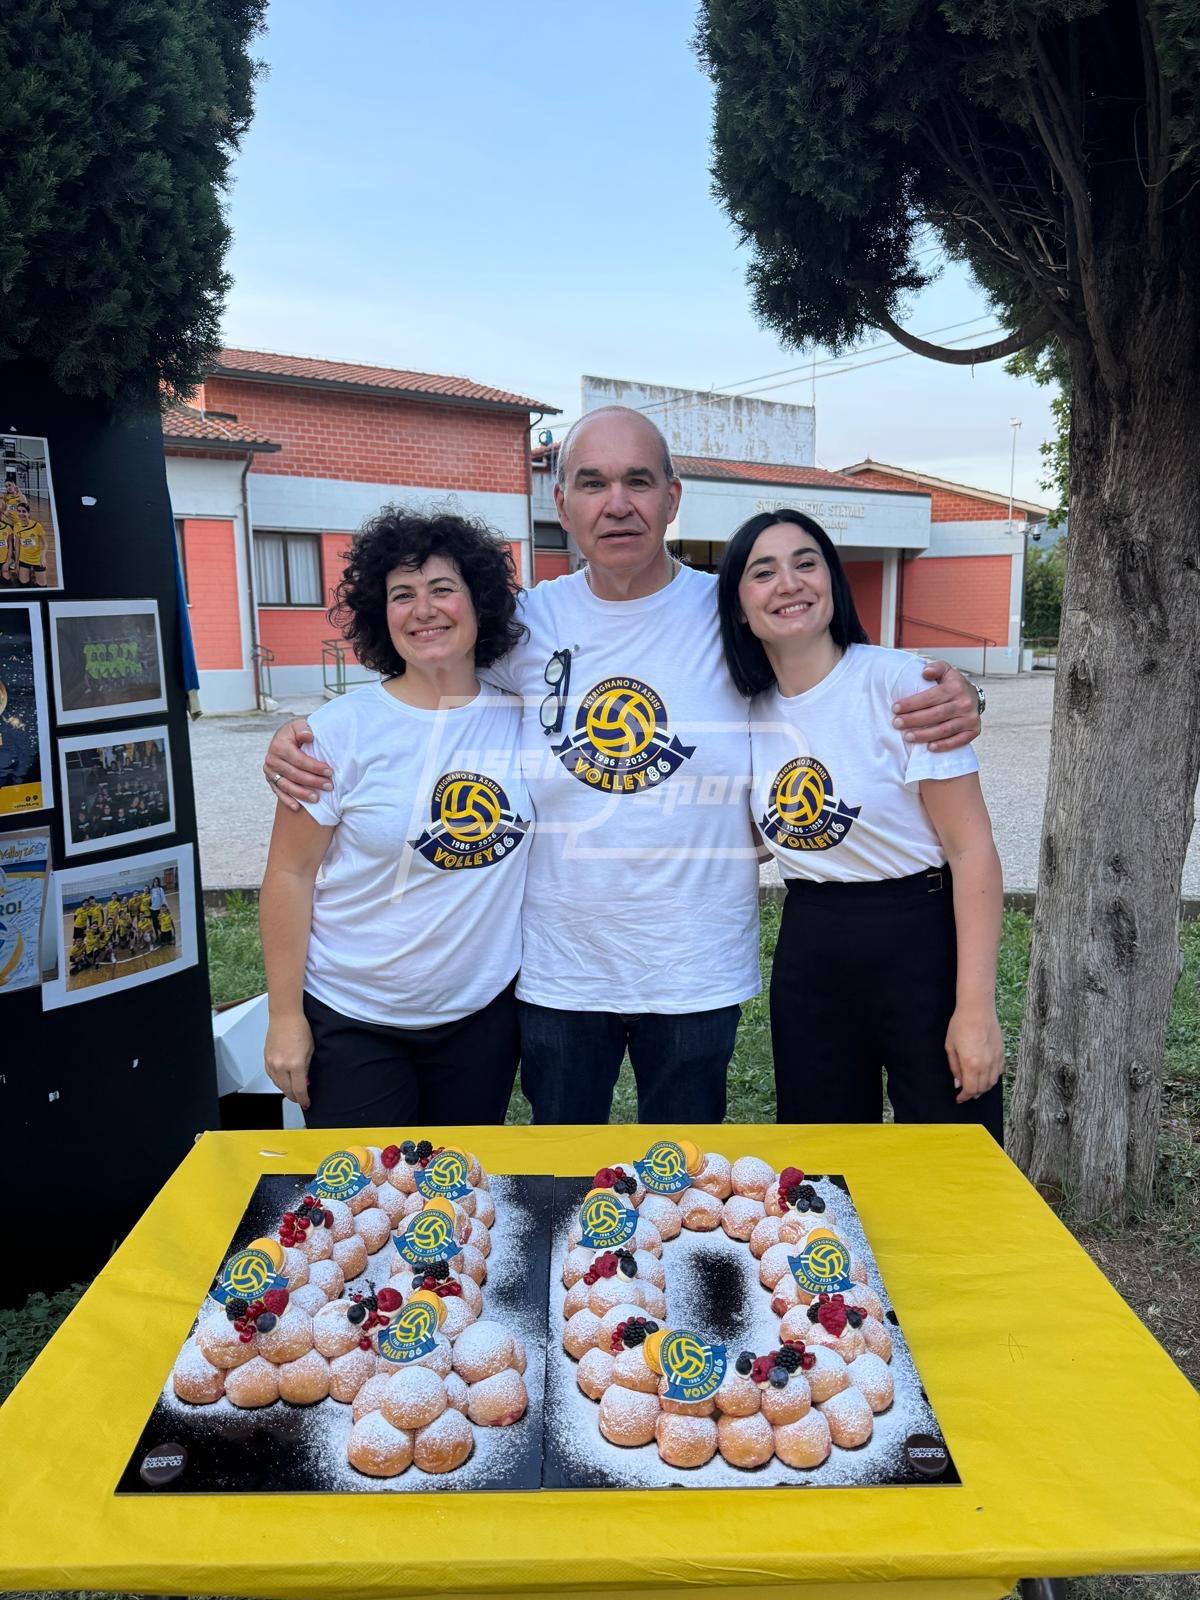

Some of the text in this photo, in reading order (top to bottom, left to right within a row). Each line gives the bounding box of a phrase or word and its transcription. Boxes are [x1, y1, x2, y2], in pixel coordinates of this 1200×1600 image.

[582, 679, 662, 710] PETRIGNANO DI ASSISI
[594, 752, 616, 766] 1986
[626, 751, 648, 766] 2026
[574, 757, 671, 790] VOLLEY86
[774, 759, 828, 789] PETRIGNANO DI ASSISI
[434, 772, 467, 802] PETRIGNANO
[479, 777, 501, 795] ASSISI
[433, 835, 515, 868] VOLLEY86
[451, 839, 470, 850] 1986
[478, 833, 497, 848] 2026
[315, 1184, 360, 1199] VOLLEY86
[641, 1170, 681, 1191] VOLLEY86
[593, 1221, 634, 1247] VOLLEY86
[794, 1268, 840, 1292] VOLLEY86
[381, 1339, 423, 1360] VOLLEY86
[683, 1359, 725, 1399] VOLLEY86
